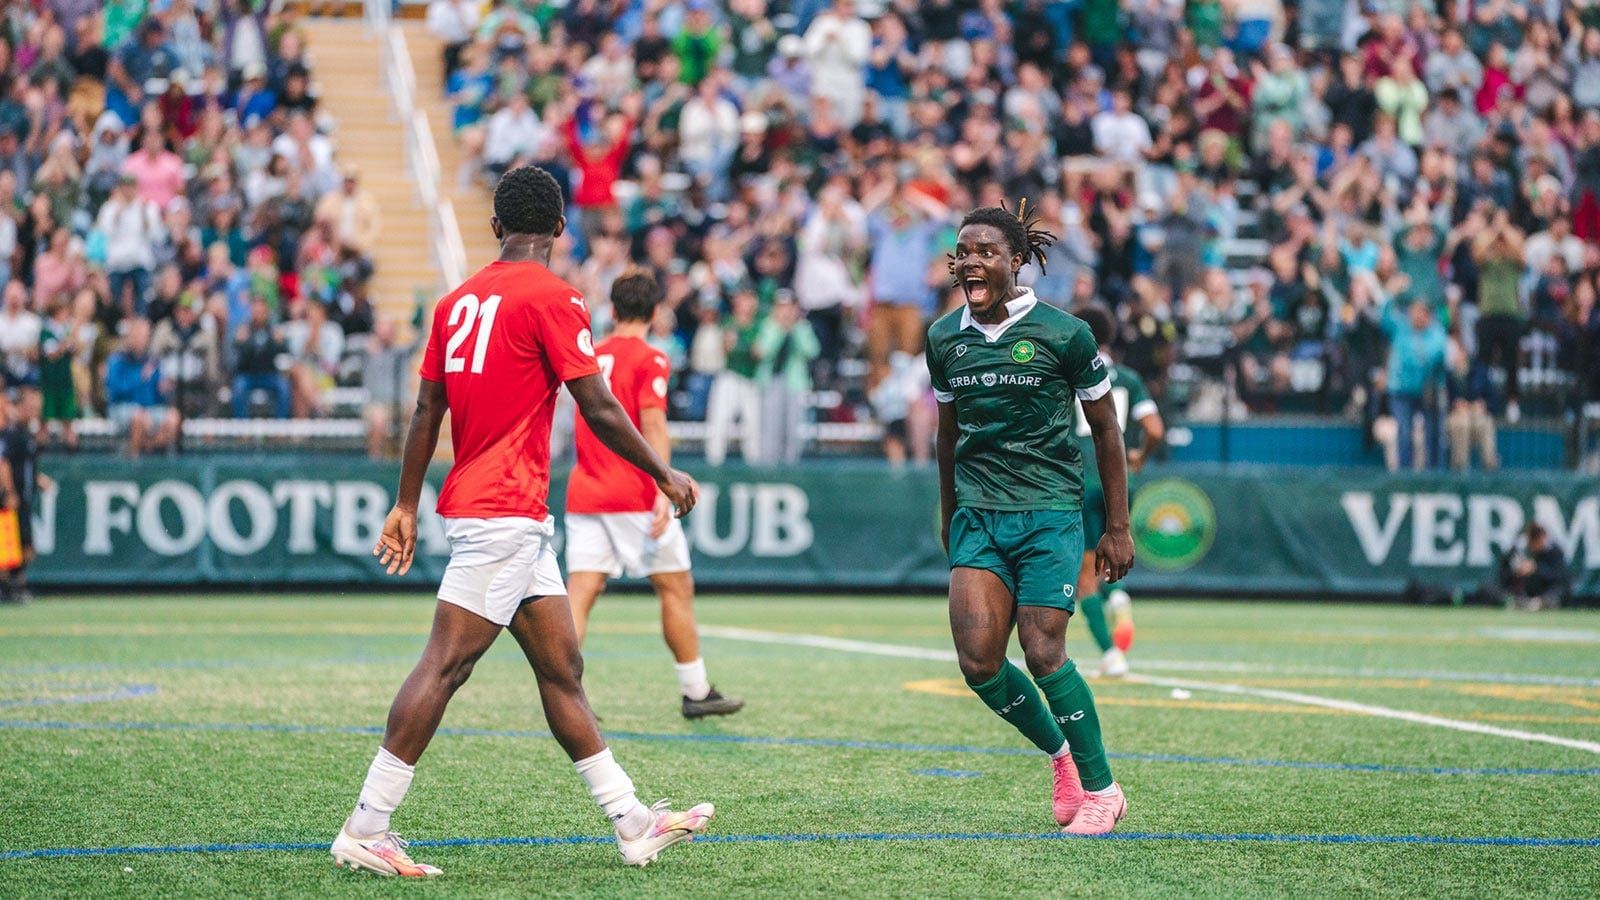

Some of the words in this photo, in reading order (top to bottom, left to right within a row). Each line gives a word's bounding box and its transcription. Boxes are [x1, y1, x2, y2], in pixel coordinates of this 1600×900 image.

[444, 293, 502, 374] 21
[1000, 374, 1042, 387] MADRE
[82, 479, 564, 557] FOOTBA
